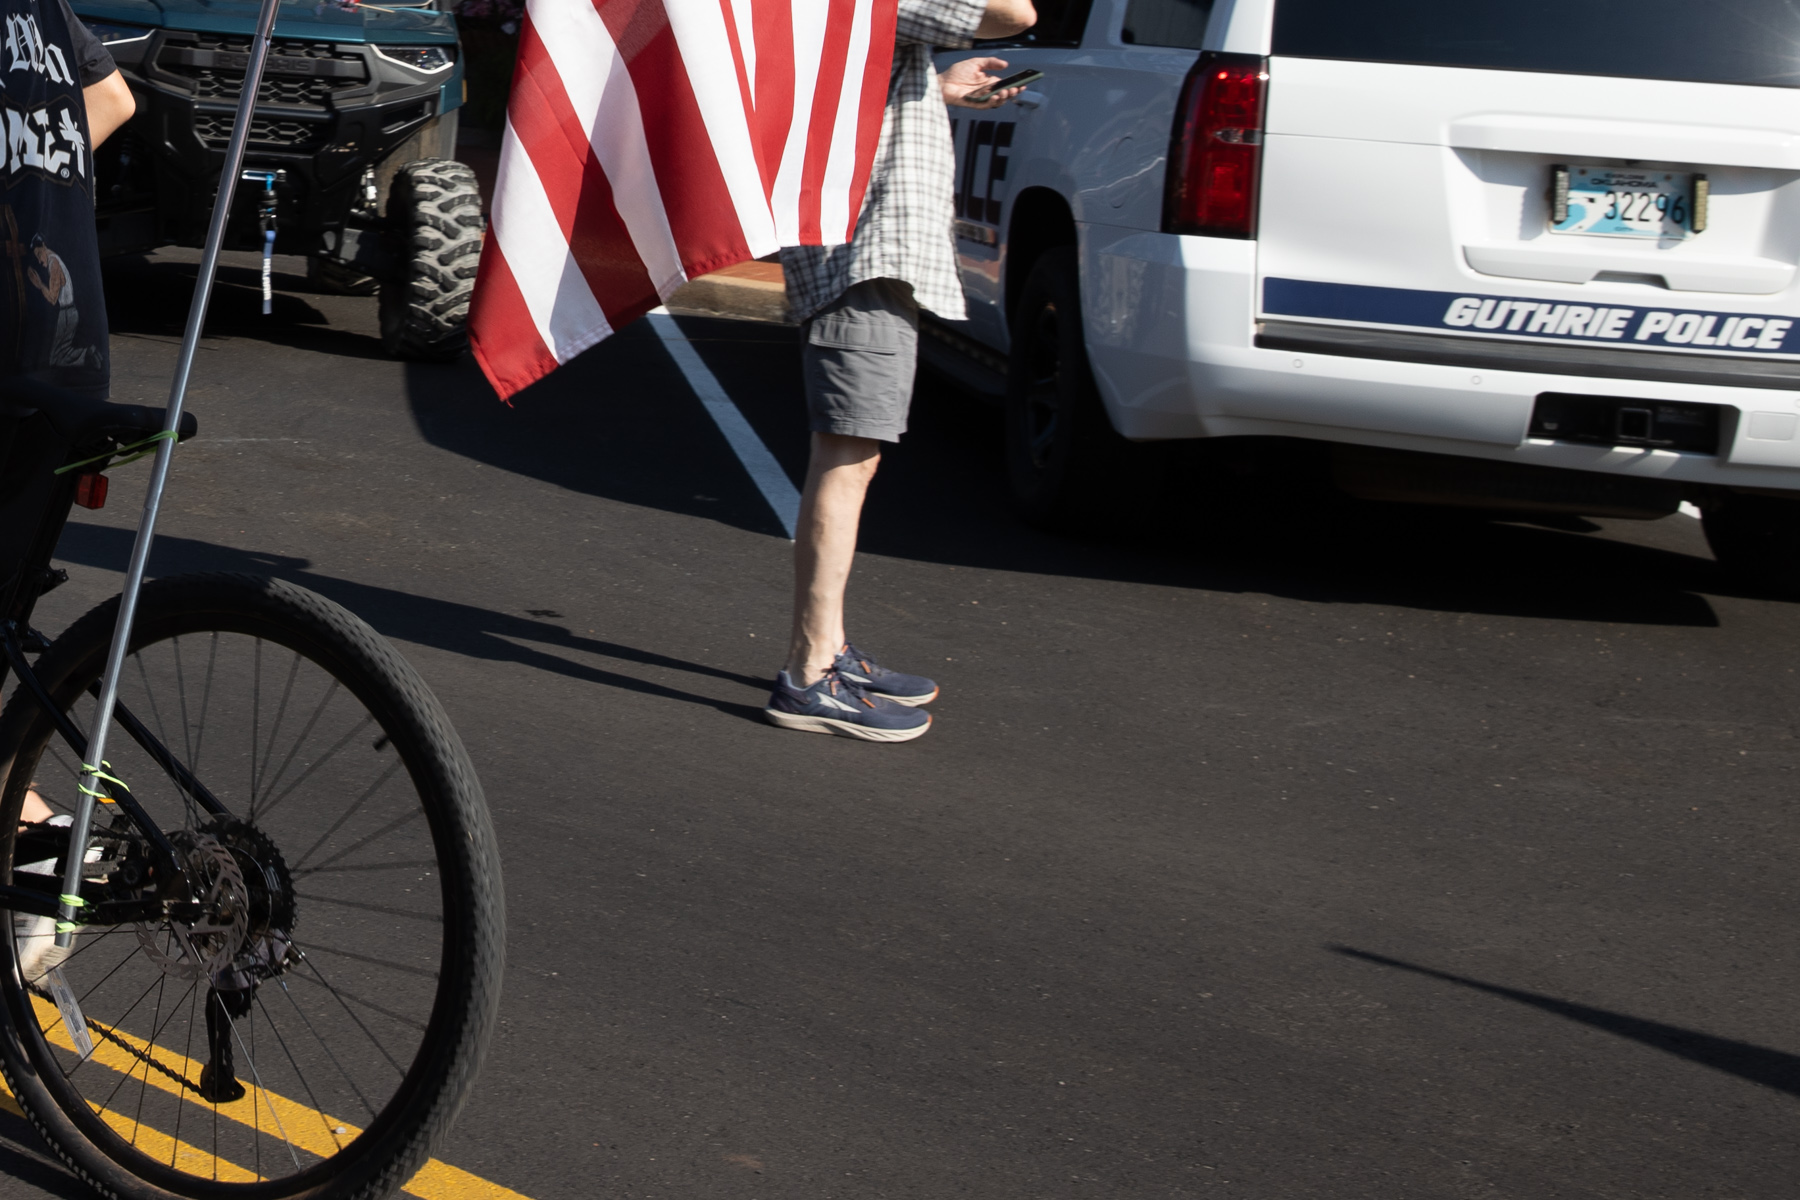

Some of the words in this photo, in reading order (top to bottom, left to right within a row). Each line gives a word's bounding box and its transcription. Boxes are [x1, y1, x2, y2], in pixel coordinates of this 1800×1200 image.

[217, 53, 313, 73] POARIS
[1590, 177, 1659, 189] OKLAHOMA
[1604, 190, 1686, 225] 32296
[1442, 296, 1636, 340] GUTHRIE
[1633, 310, 1794, 351] POLICE
